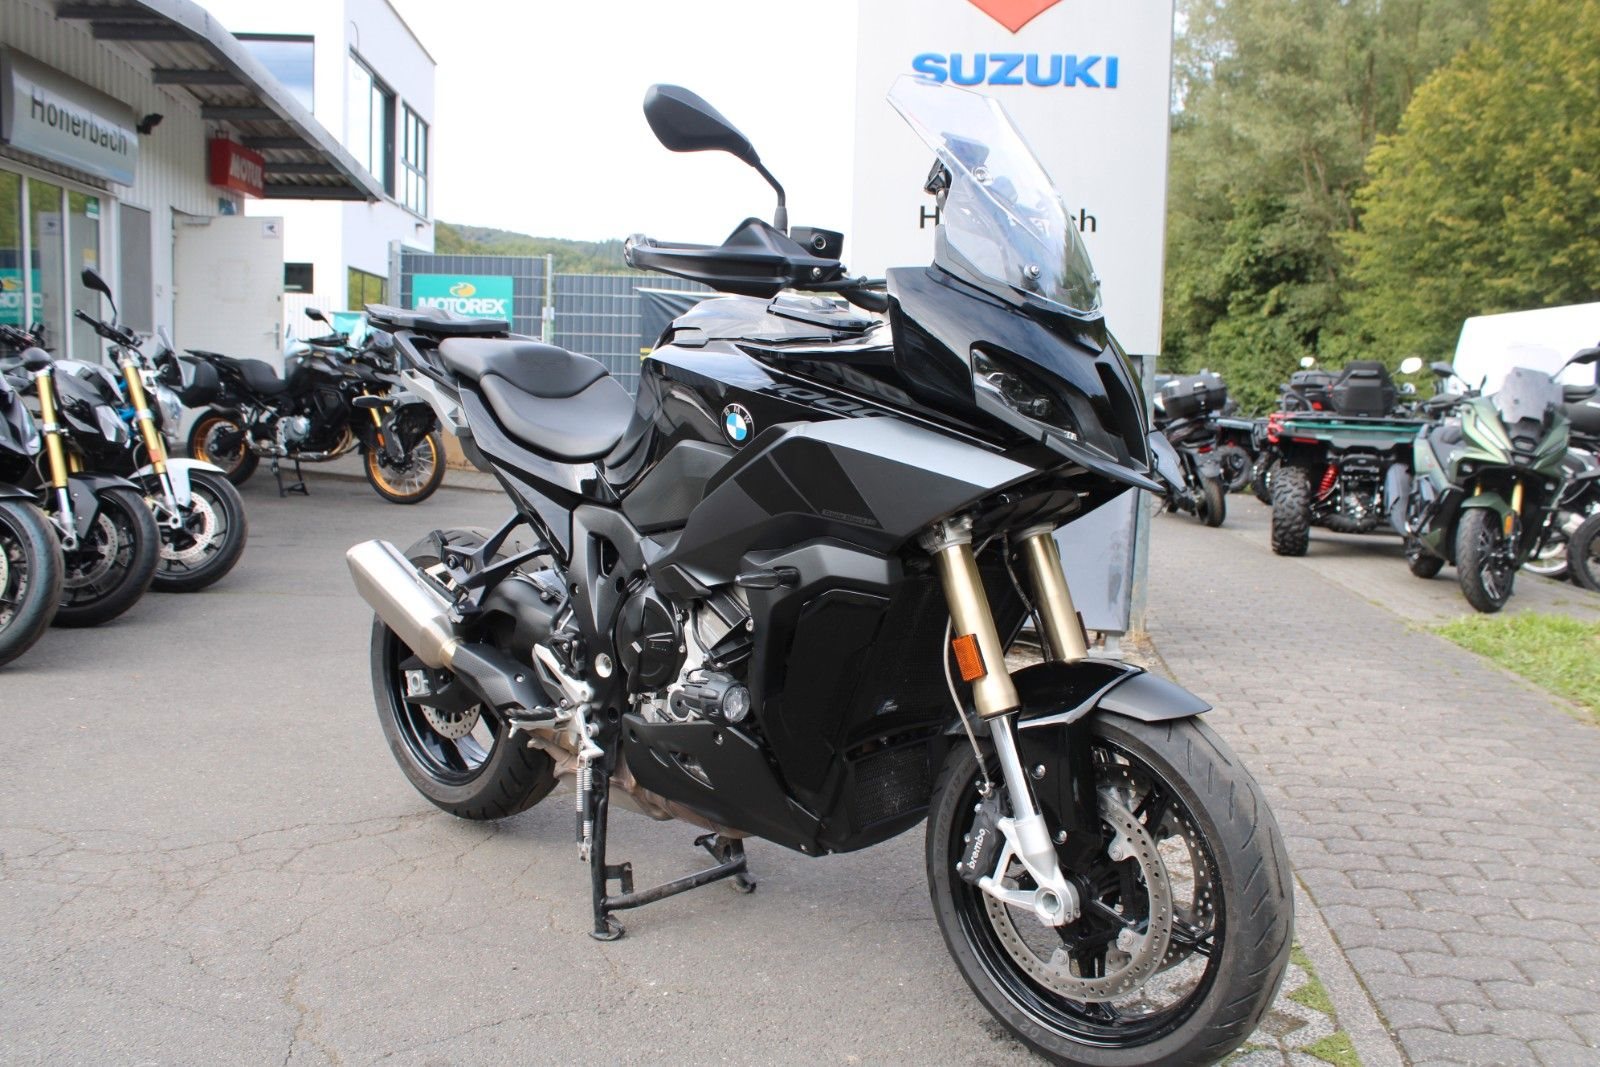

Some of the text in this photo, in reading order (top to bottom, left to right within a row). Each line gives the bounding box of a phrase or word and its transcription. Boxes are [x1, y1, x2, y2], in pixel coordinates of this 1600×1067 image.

[912, 53, 1119, 88] SUZUKI
[417, 297, 507, 314] MOTOREX
[723, 405, 752, 424] BMW
[967, 828, 986, 870] brembo
